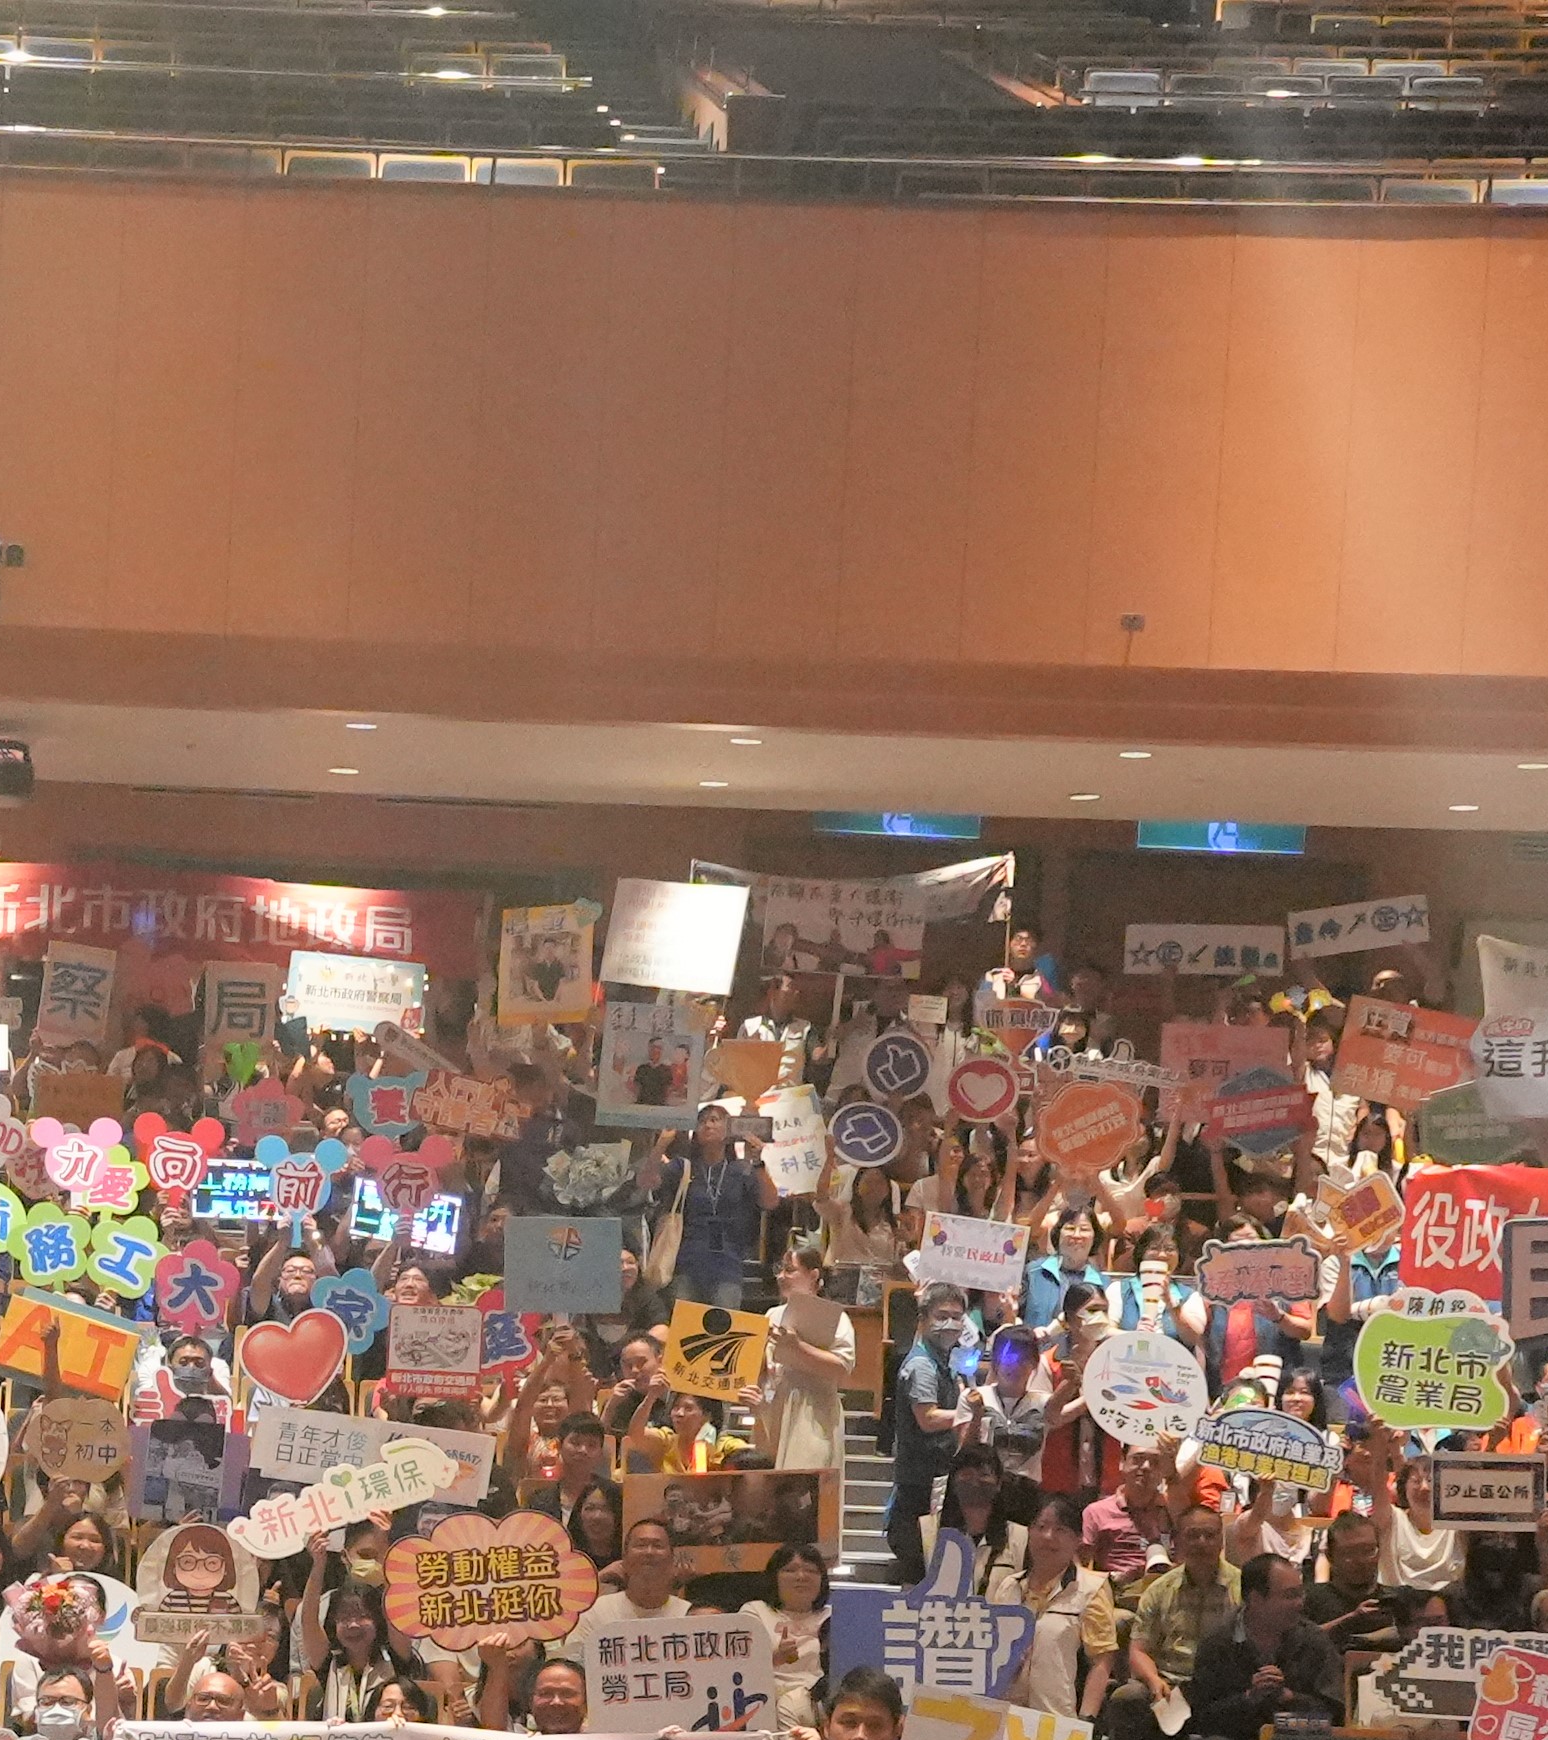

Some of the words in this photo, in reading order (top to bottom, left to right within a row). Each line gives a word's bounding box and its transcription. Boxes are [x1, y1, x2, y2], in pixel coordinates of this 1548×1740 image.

[46, 961, 109, 1022] 察
[209, 979, 268, 1040] 局
[305, 983, 402, 1005] 新北市政府警察局
[56, 1140, 102, 1184] 力
[153, 1137, 203, 1190] 向
[780, 1151, 822, 1175] 科長
[87, 1167, 133, 1208] 愛
[276, 1161, 321, 1209] 前
[384, 1161, 430, 1208] 行
[24, 1225, 75, 1275] 務
[97, 1236, 153, 1285] 工
[167, 1263, 218, 1315] 大
[1380, 1339, 1490, 1380] 新北市
[1374, 1373, 1483, 1415] 農業局
[74, 1443, 118, 1465] 初中
[278, 1419, 369, 1450] 青年才俊
[1195, 1415, 1342, 1469] 新北市政府漁業及
[1199, 1441, 1328, 1487] 漁港事業管理處
[1445, 1484, 1530, 1499] 汐止區公所
[416, 1546, 559, 1588] 勞動權益
[418, 1583, 562, 1630] 新北挺你
[598, 1628, 754, 1668] 新北市政府
[880, 1599, 992, 1703] 讚
[600, 1669, 693, 1703] 勞工局
